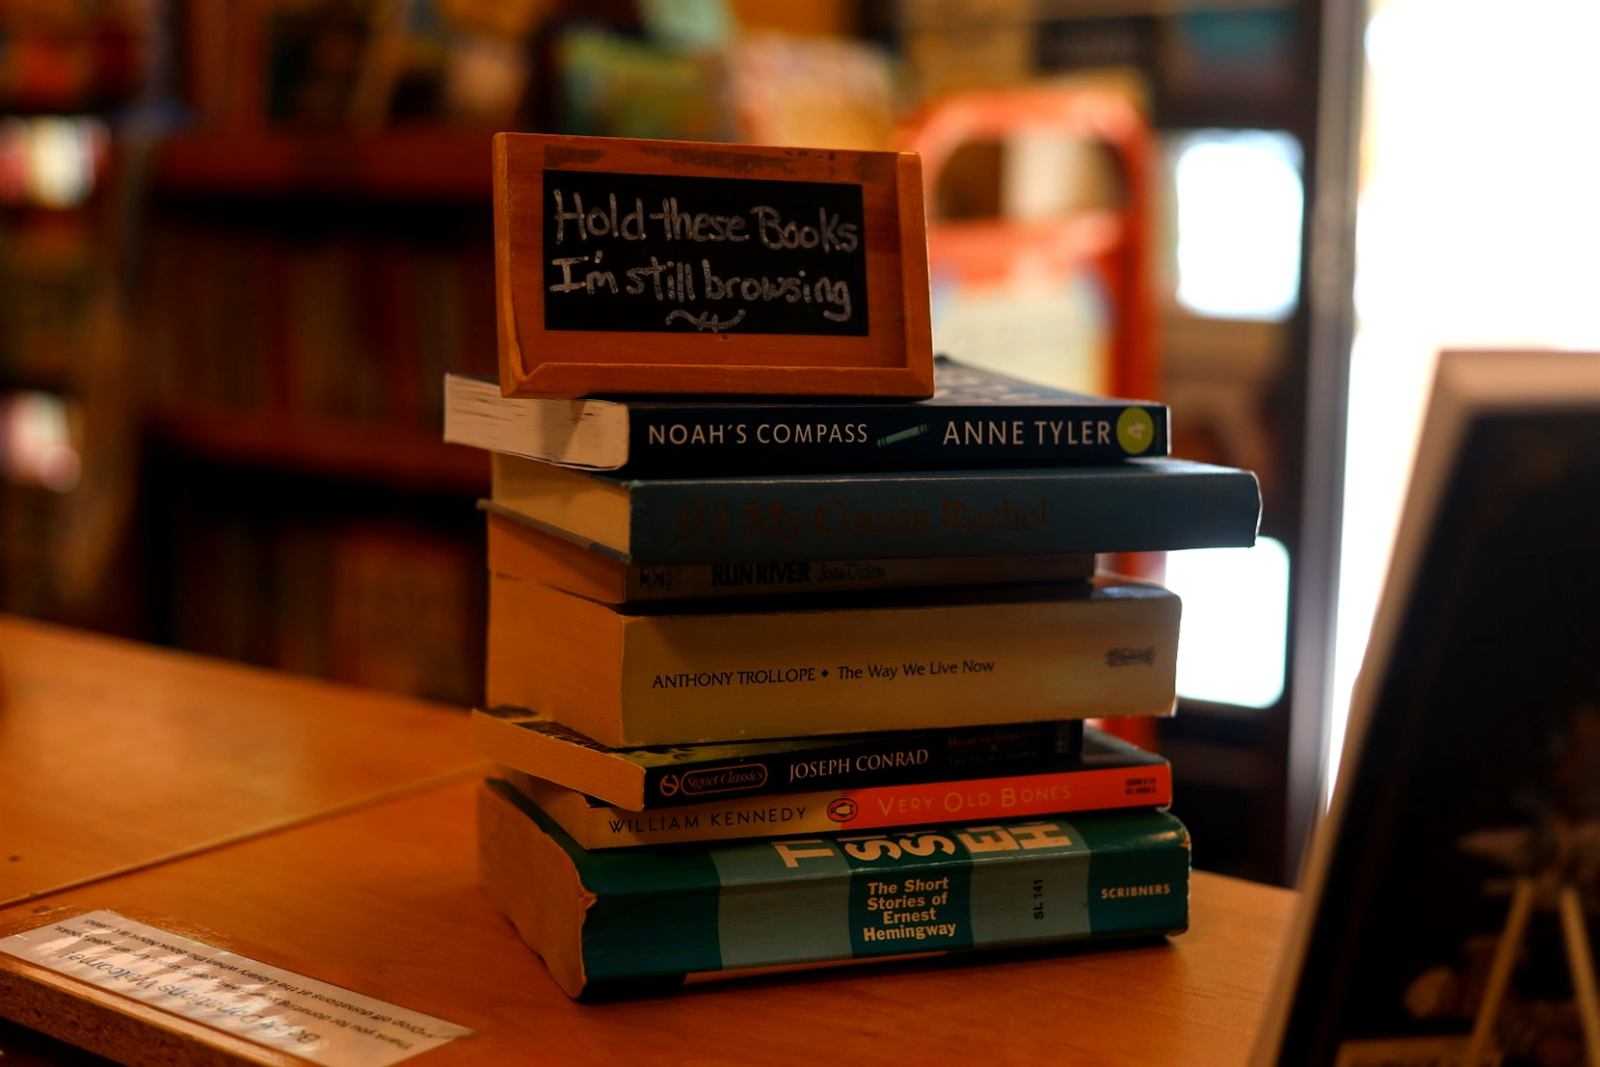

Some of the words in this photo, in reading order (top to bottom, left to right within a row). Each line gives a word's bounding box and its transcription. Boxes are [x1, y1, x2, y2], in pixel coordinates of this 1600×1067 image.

[552, 188, 647, 245] Hold
[649, 196, 750, 242] these
[751, 204, 859, 254] Books
[549, 249, 619, 296] I'm
[625, 256, 696, 302] still
[701, 258, 851, 322] browsing
[648, 423, 748, 446] NOAH'S
[756, 423, 869, 445] COMPASS
[942, 419, 1025, 446] ANNE
[1033, 419, 1112, 446] TYLER
[744, 499, 804, 545] My
[815, 498, 930, 538] Cousin
[941, 497, 1049, 533] Rachel
[712, 561, 752, 586] RUN
[756, 560, 810, 585] RIVER
[652, 670, 734, 689] ANTHONY
[737, 667, 816, 686] TROLLOPE
[837, 666, 863, 680] The
[868, 664, 898, 680] Way
[903, 663, 926, 677] We
[930, 661, 958, 676] Live
[962, 659, 995, 674] Now
[720, 768, 764, 786] Classics
[788, 757, 851, 784] JOSEPH
[855, 748, 929, 773] CONRAD
[878, 796, 933, 817] VERY
[944, 791, 992, 813] OLD
[1001, 784, 1072, 808] BONES
[609, 815, 699, 833] WILLIAM
[711, 807, 807, 827] KENNEDY
[867, 881, 898, 895] The
[904, 876, 949, 893] Short
[1033, 879, 1043, 899] 141
[1101, 883, 1171, 900] SCRIBNERS
[866, 895, 926, 911] Stories
[931, 891, 949, 906] of
[1033, 903, 1044, 920] SL
[883, 906, 937, 925] Ernest
[863, 923, 957, 942] Hemingway
[311, 993, 374, 1016] donations
